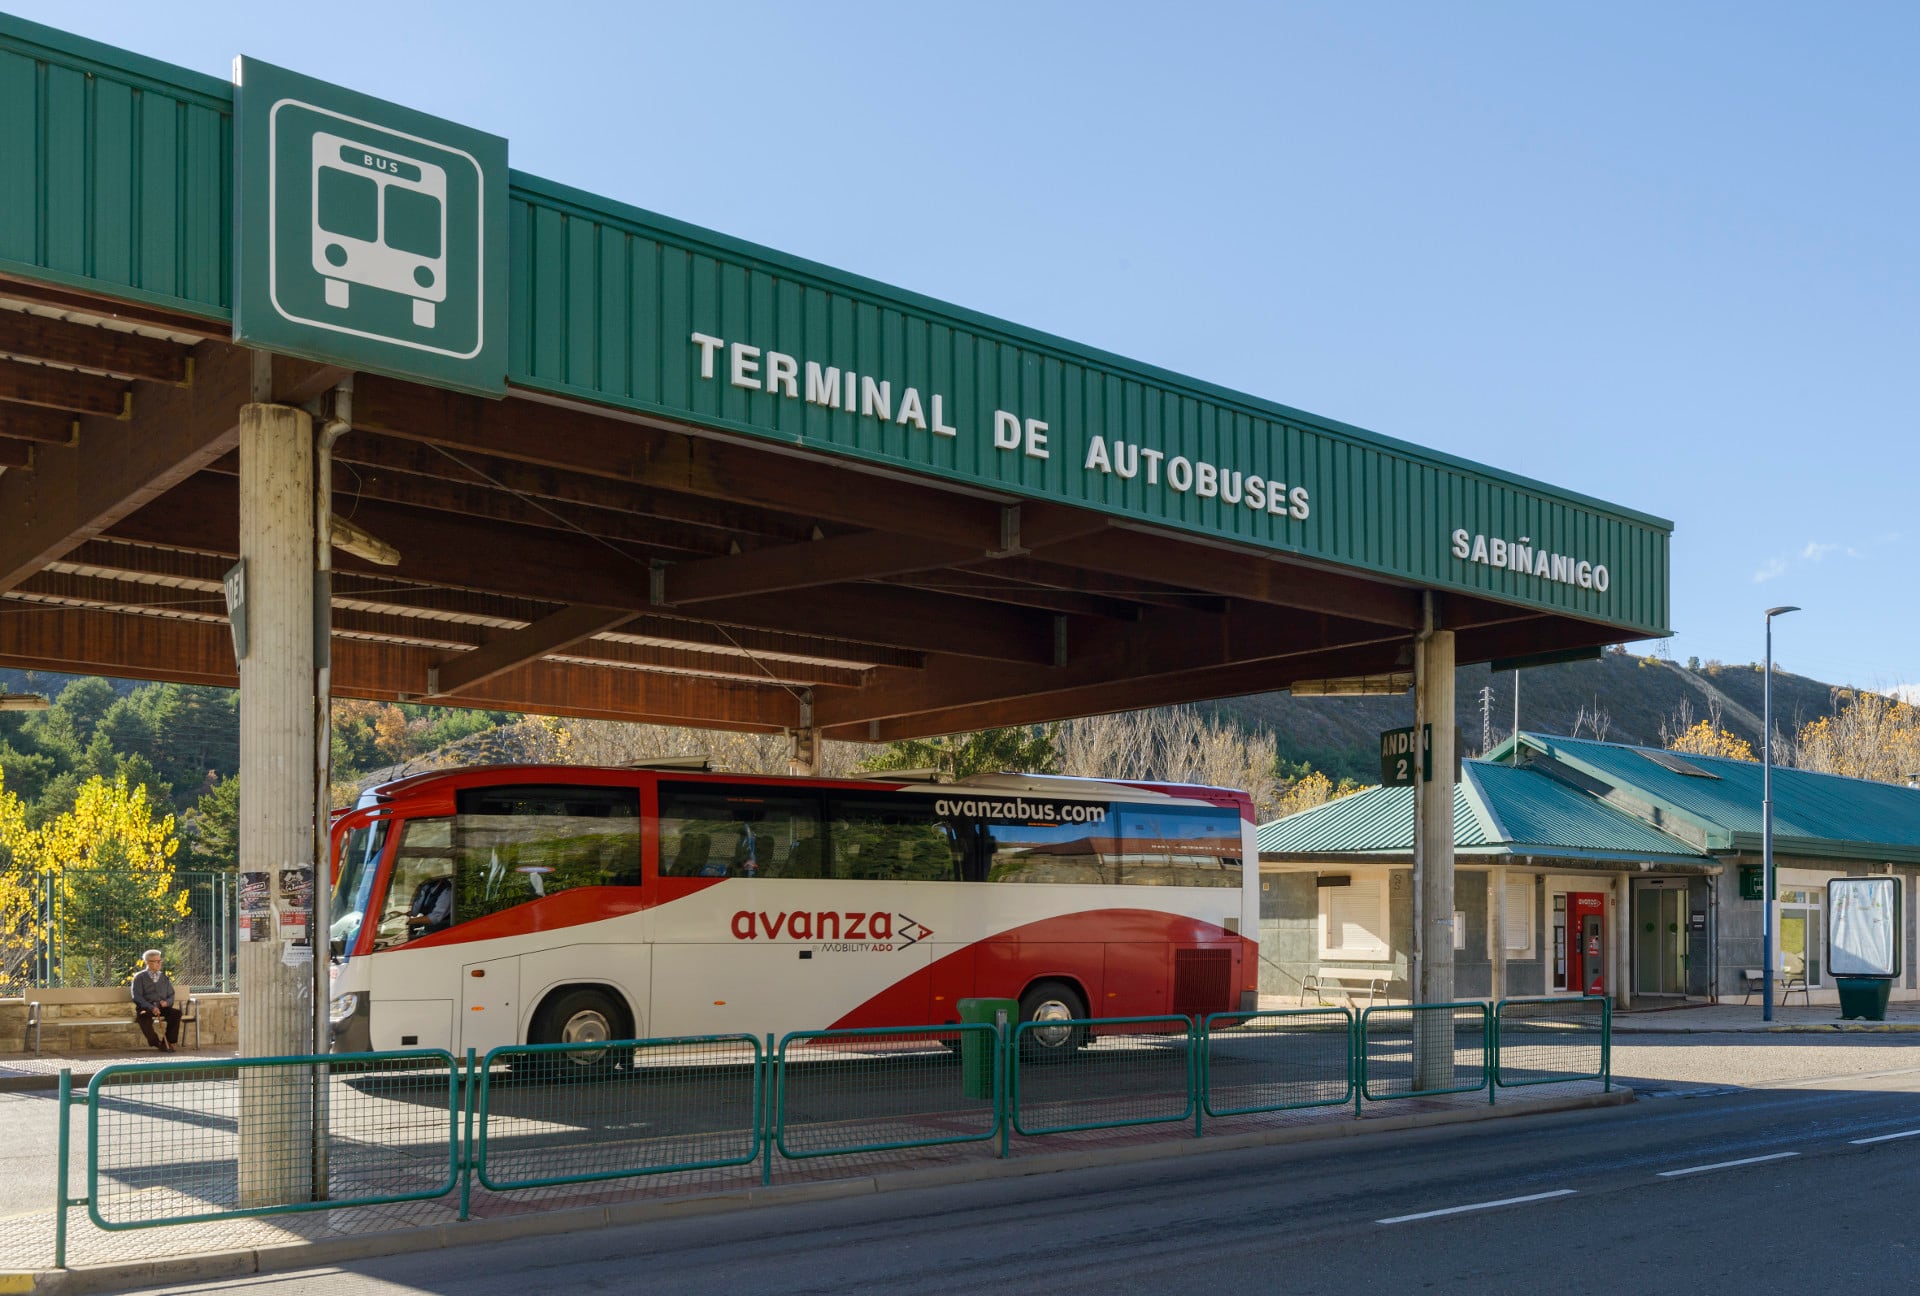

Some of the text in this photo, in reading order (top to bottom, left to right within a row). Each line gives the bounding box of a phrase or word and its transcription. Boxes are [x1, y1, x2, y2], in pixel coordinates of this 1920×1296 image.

[364, 154, 399, 173] BUS
[691, 332, 1310, 520] TERMINAL DE AUTOBUSES
[1452, 528, 1609, 592] SABIÑANIGO
[1396, 759, 1408, 780] 2
[936, 798, 1105, 822] avanzabus.com
[731, 911, 893, 940] avanza
[821, 943, 869, 952] MOBILITY
[871, 944, 893, 952] ADO
